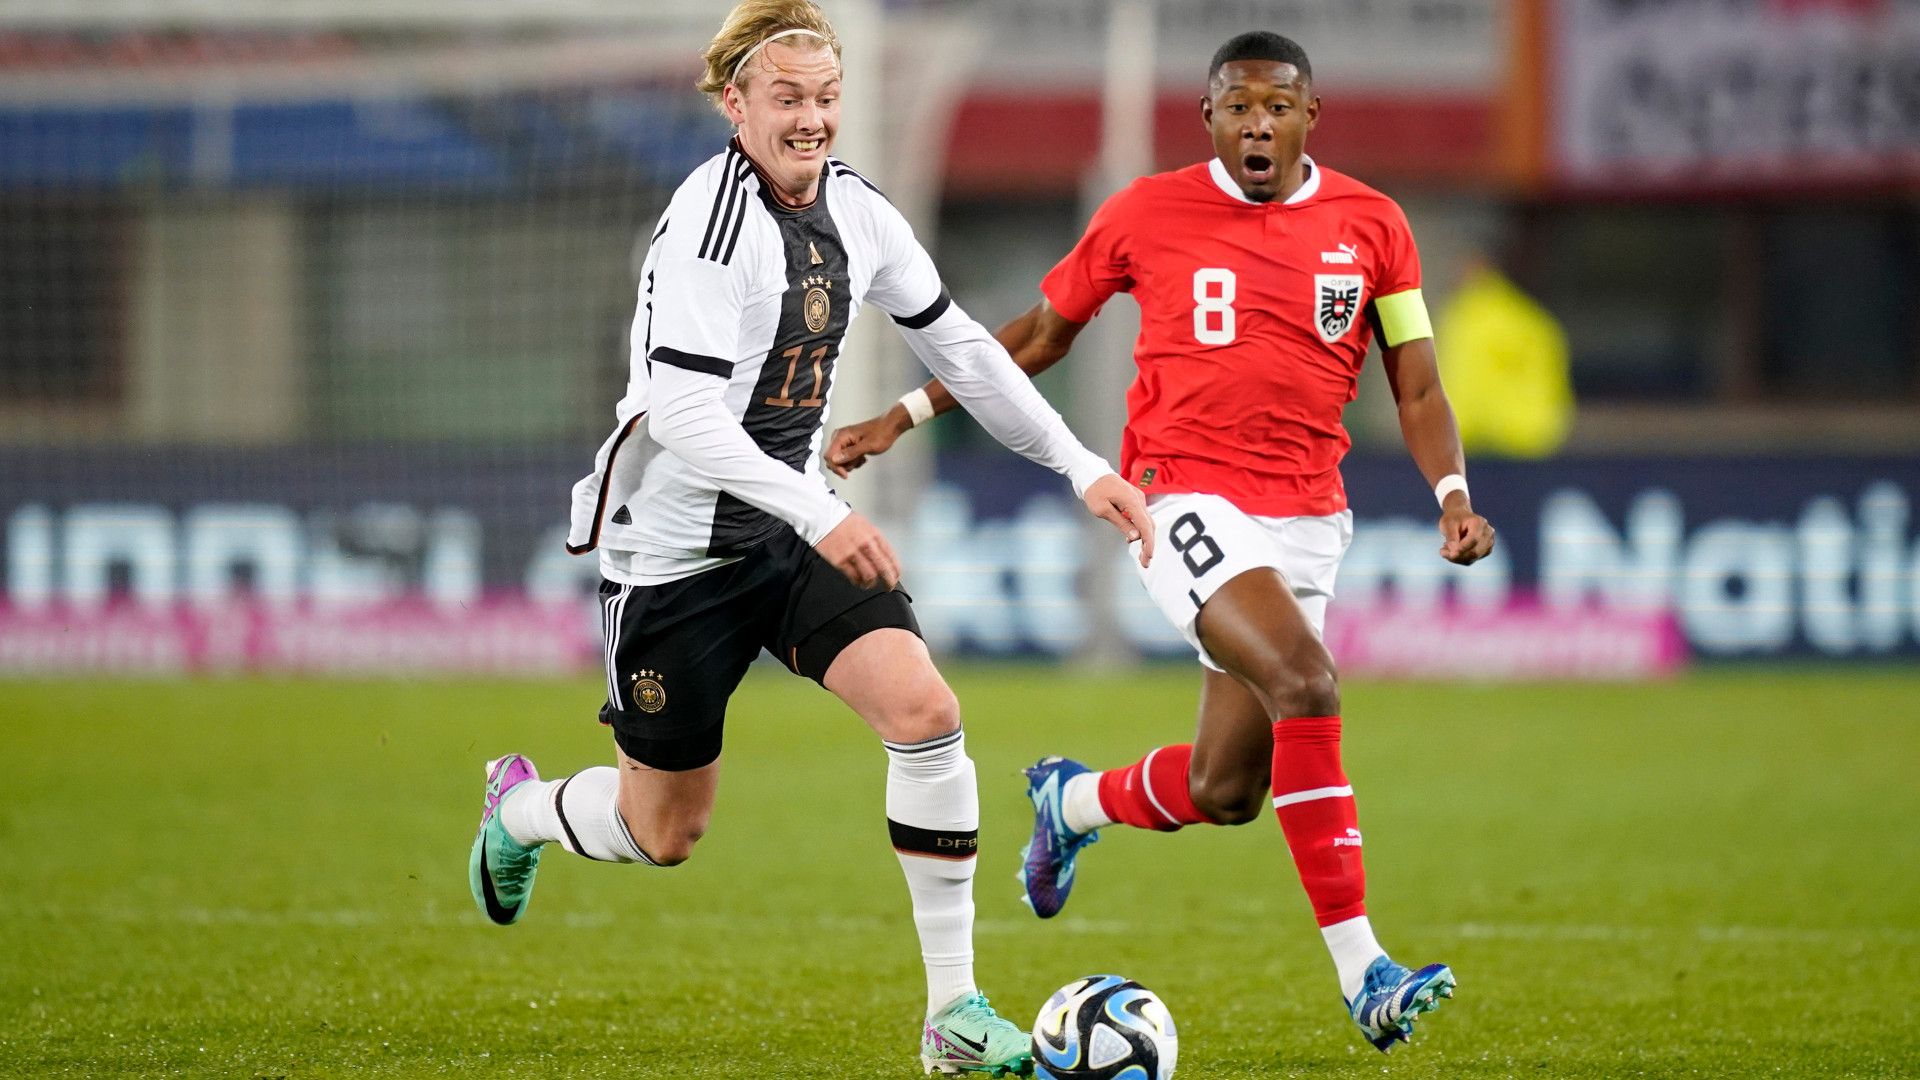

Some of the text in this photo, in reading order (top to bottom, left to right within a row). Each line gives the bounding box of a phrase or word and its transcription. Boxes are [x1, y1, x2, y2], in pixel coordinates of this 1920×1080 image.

[1193, 267, 1237, 345] 8
[765, 344, 828, 408] 11
[1168, 511, 1225, 578] 8
[1540, 480, 1920, 653] Nati
[937, 837, 977, 849] DFB
